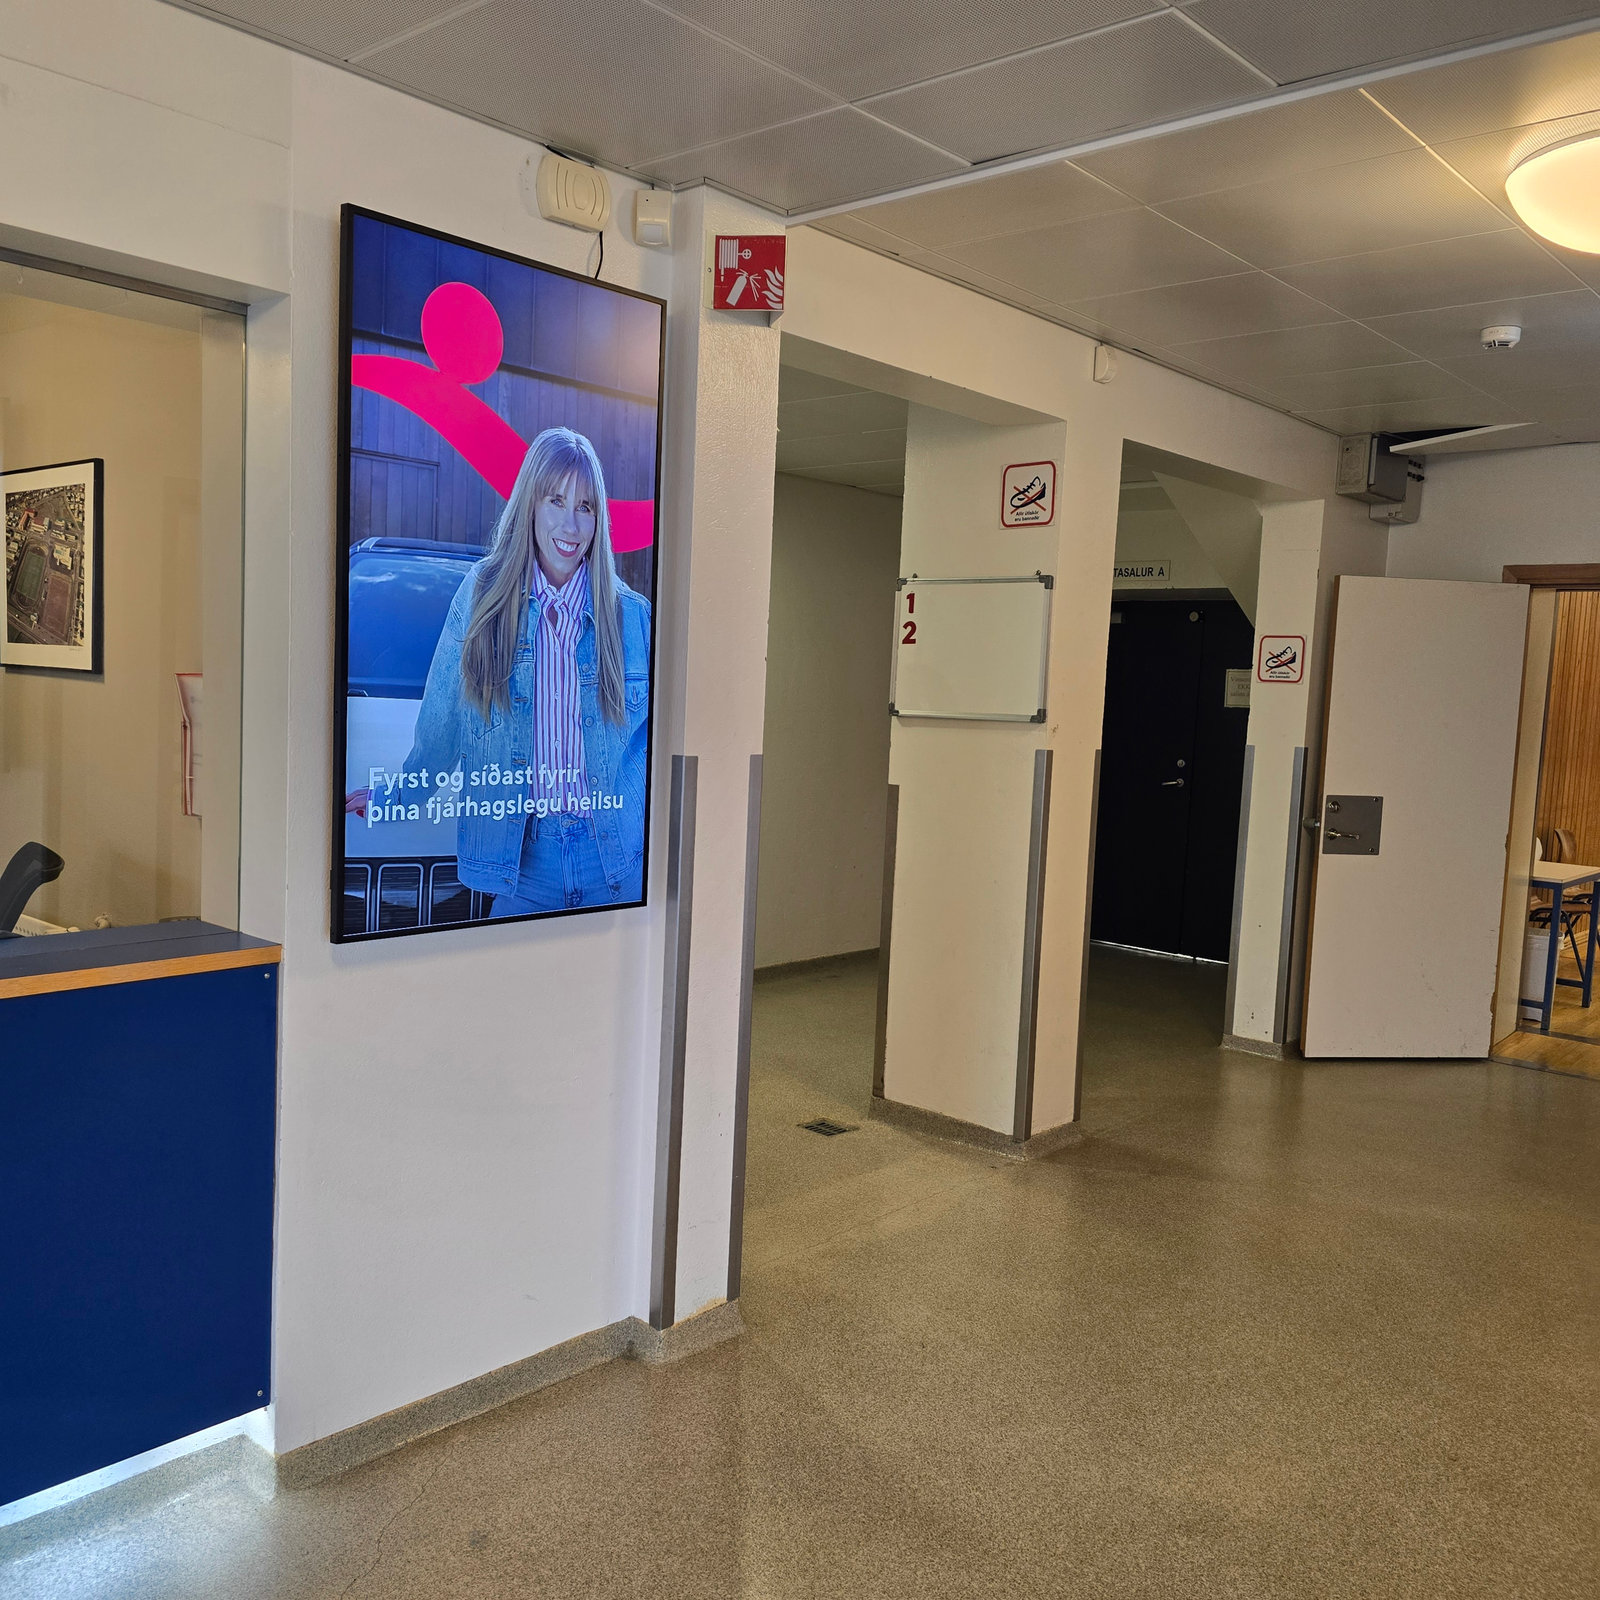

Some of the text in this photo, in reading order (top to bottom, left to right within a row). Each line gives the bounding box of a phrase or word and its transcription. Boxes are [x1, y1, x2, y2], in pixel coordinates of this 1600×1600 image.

[1113, 566, 1165, 578] TASALUR A
[906, 593, 915, 614] 1
[902, 621, 917, 645] 2
[368, 763, 581, 795] Fyrst og síðast fyrir
[367, 791, 624, 828] þína fjárhagslegu heilsu
